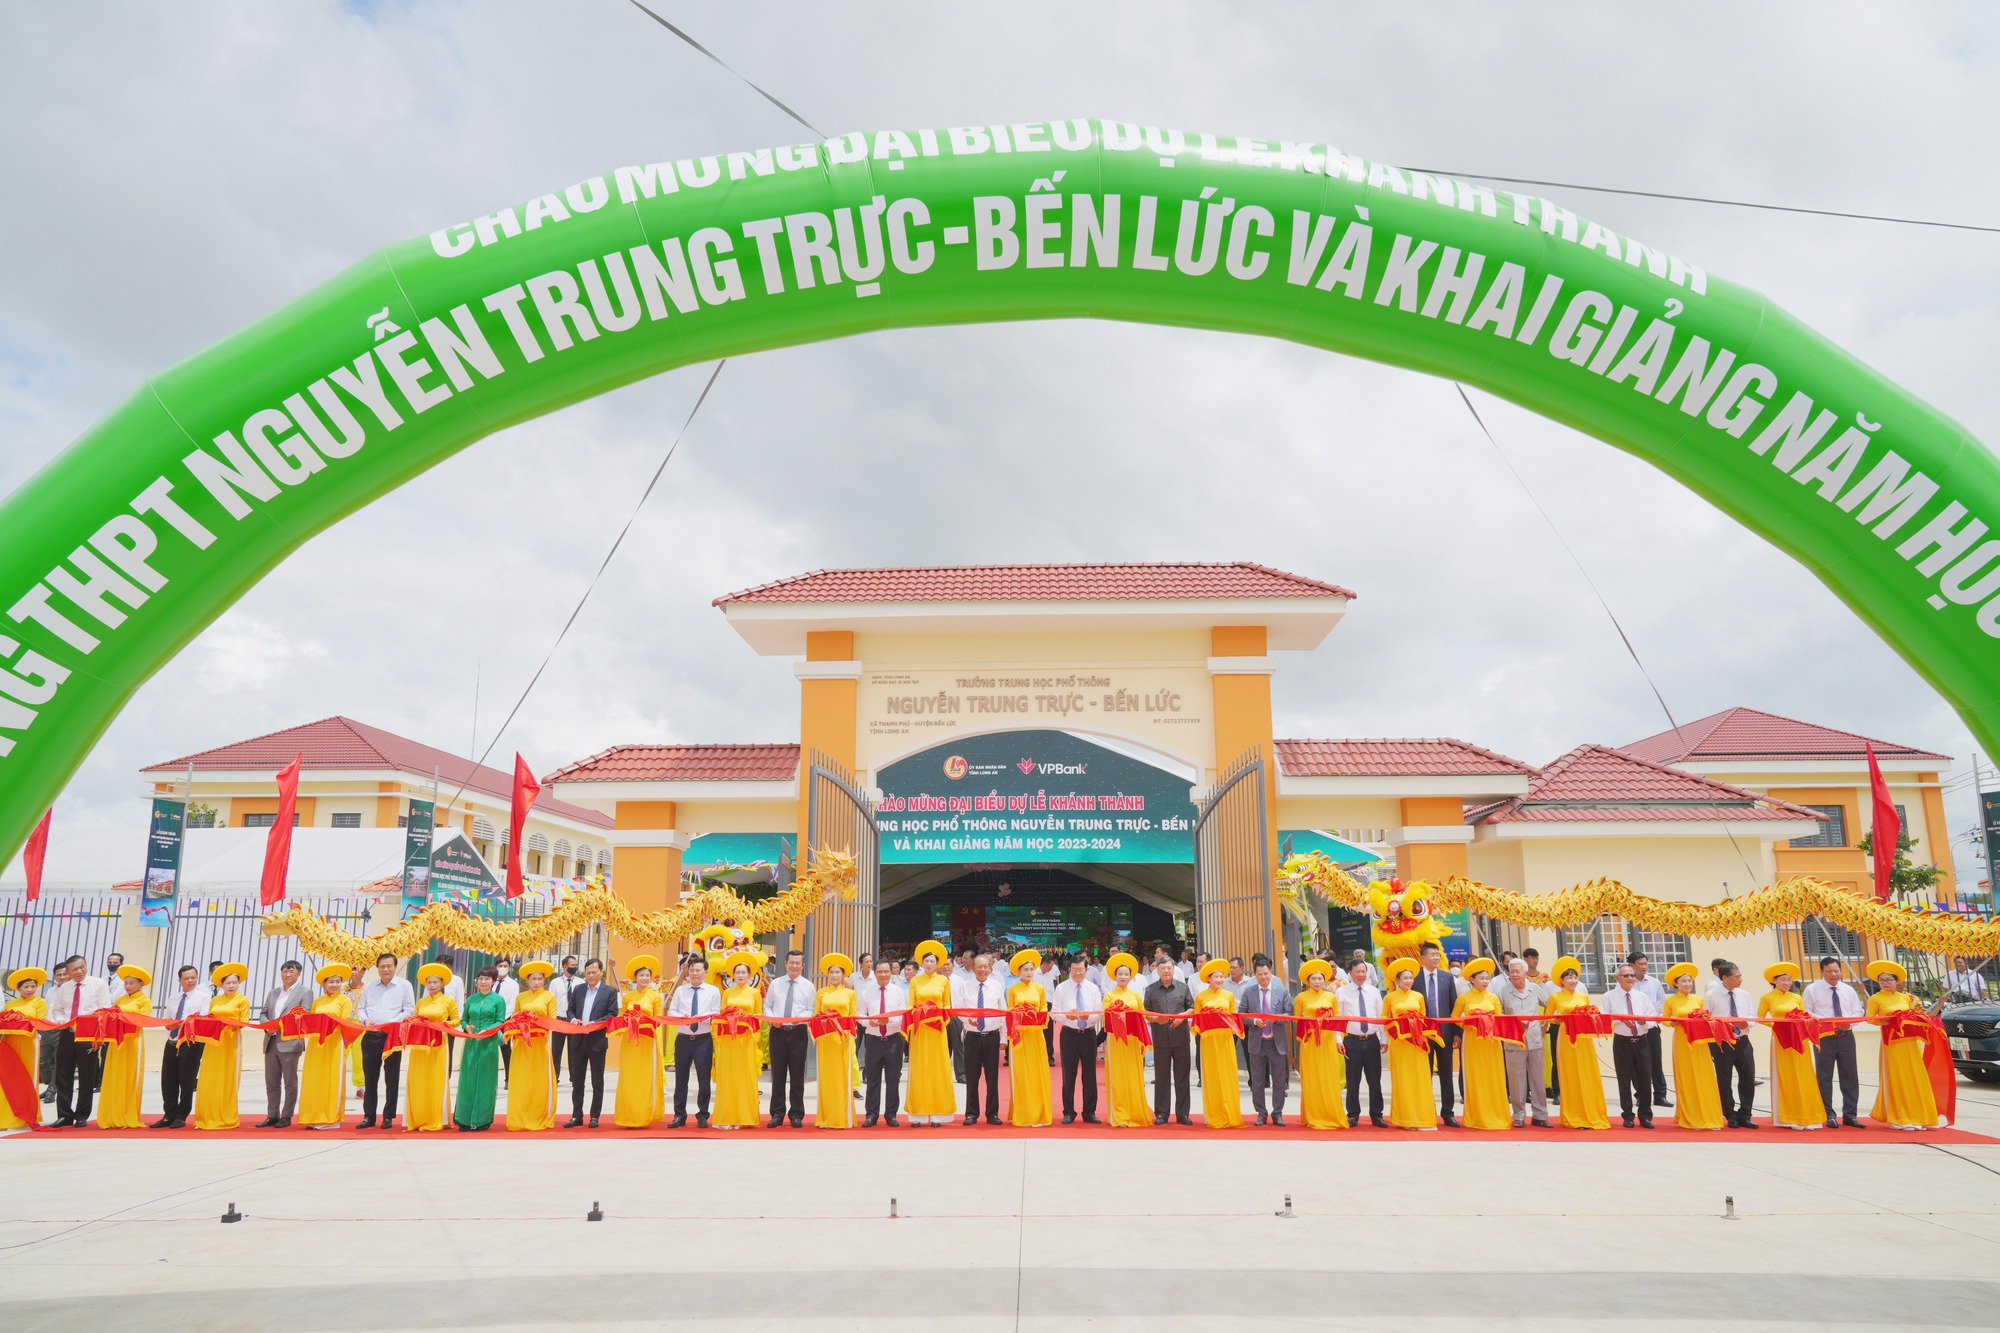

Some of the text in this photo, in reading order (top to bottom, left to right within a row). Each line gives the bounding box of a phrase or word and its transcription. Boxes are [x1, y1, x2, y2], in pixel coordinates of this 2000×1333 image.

[5, 475, 217, 655] THPT
[181, 303, 505, 521] NGUYỄN
[482, 227, 746, 364] TRUNG
[742, 194, 935, 299] TRỰC
[973, 170, 1121, 271] BẾN
[1132, 186, 1275, 281] LỨC
[1287, 205, 1373, 300] VÀ
[1374, 233, 1564, 346] KHAI
[1548, 290, 1778, 439] GIẢNG
[1747, 390, 1941, 541] NĂM
[956, 676, 996, 688] TRƯỜNG
[999, 678, 1030, 688] TRUNG
[1033, 678, 1053, 690] HỌC
[1077, 676, 1110, 687] THÔNG
[887, 691, 960, 714] NGUYỄN
[966, 694, 1028, 713] TRUNG
[1035, 692, 1084, 716] TRỰC
[1104, 688, 1139, 712] BẾN
[1145, 688, 1181, 712] LỨC
[1038, 763, 1088, 774] VPBank
[876, 789, 1144, 815] HÀO MỪNG ĐẠI BIỂU DỰ LỄ KHÁNH THÀNH
[902, 820, 929, 834] HỌC
[932, 815, 958, 831] PHỔ
[962, 817, 1007, 831] THÔNG
[1011, 814, 1064, 830] NGUYỄN
[1068, 819, 1112, 830] TRUNG
[1116, 817, 1150, 833] TRỰC
[1162, 815, 1188, 830] BẾN
[893, 835, 1121, 852] VÀ KHAI GIẢNG NĂM HỌC 2023-2024
